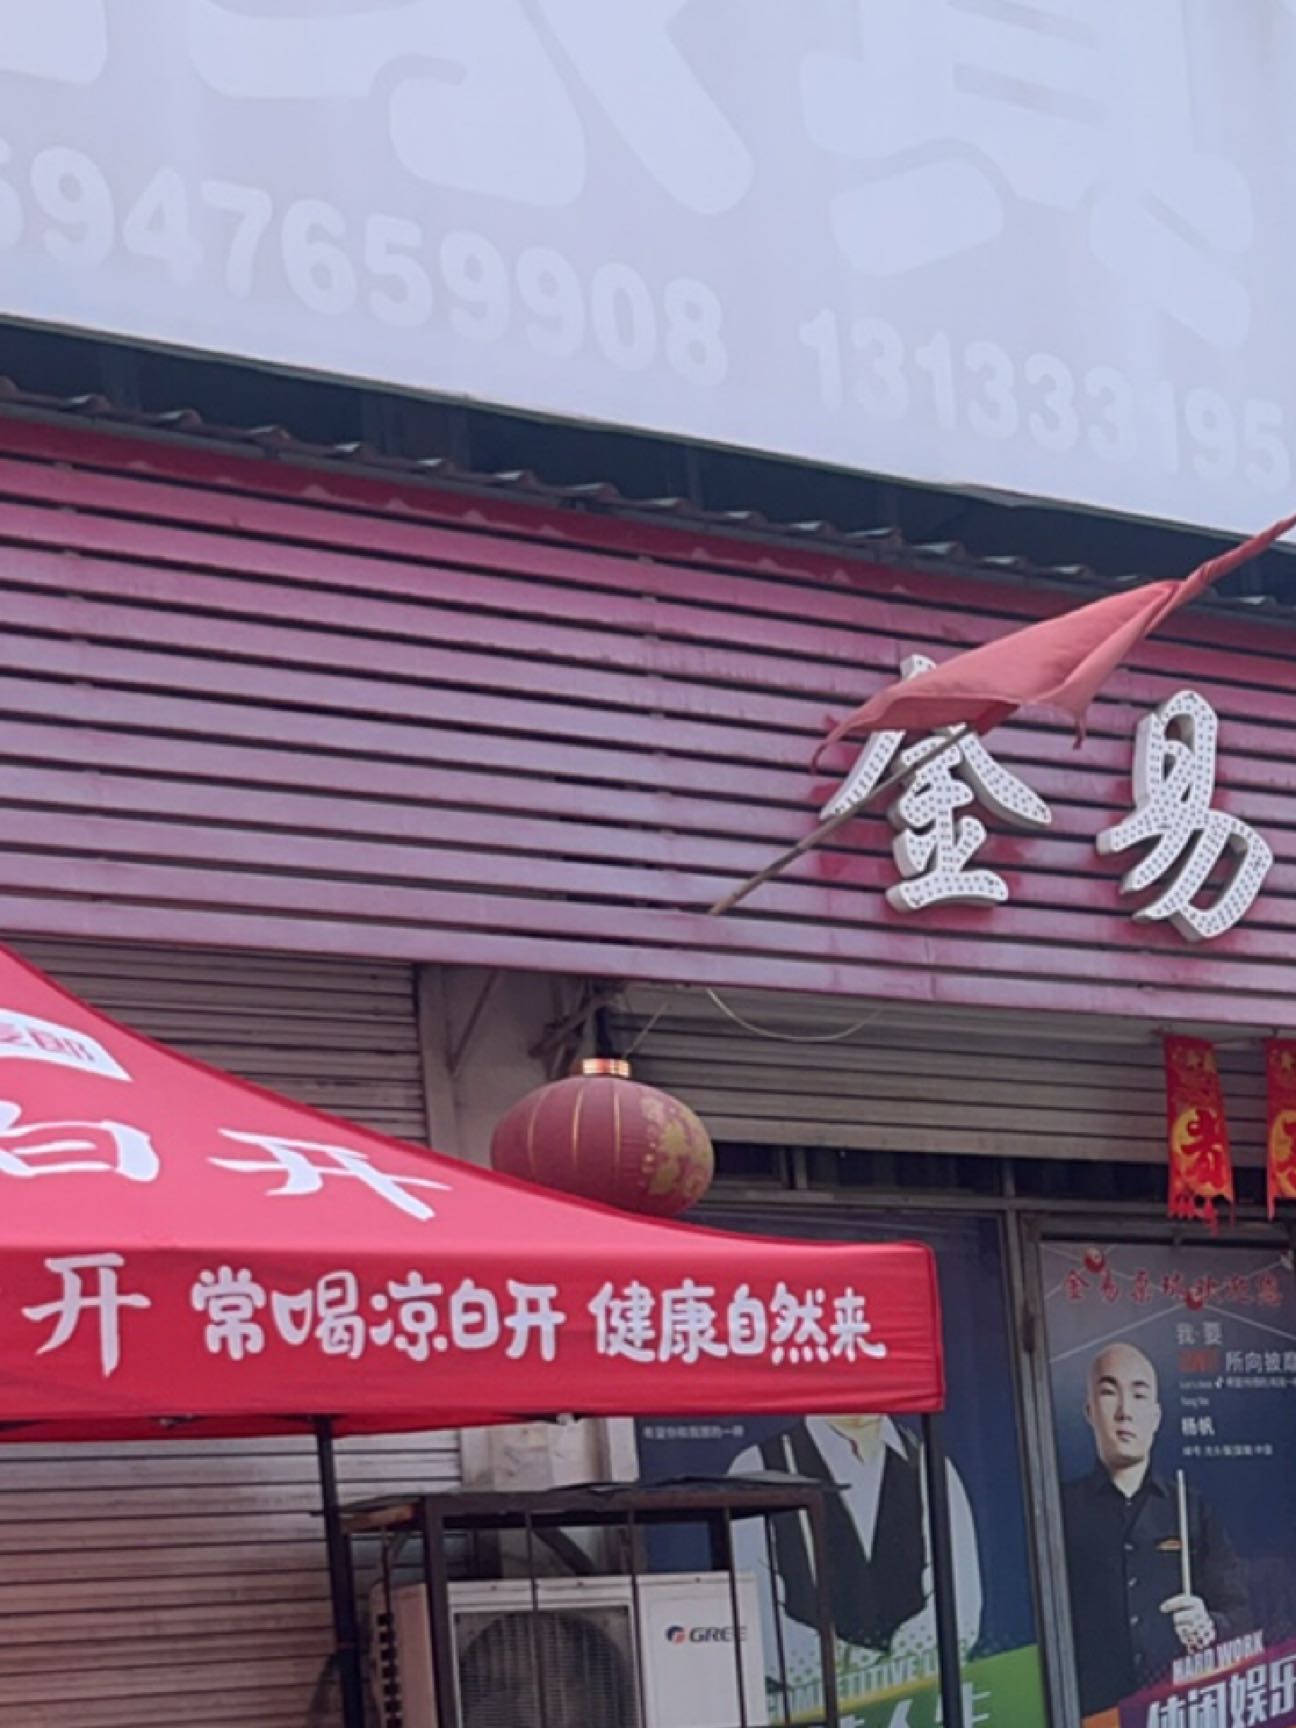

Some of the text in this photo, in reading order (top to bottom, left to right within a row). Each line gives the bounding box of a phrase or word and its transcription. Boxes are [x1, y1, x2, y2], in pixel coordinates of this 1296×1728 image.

[22, 1253, 886, 1377] 开 常喝凉白开 健康自然来
